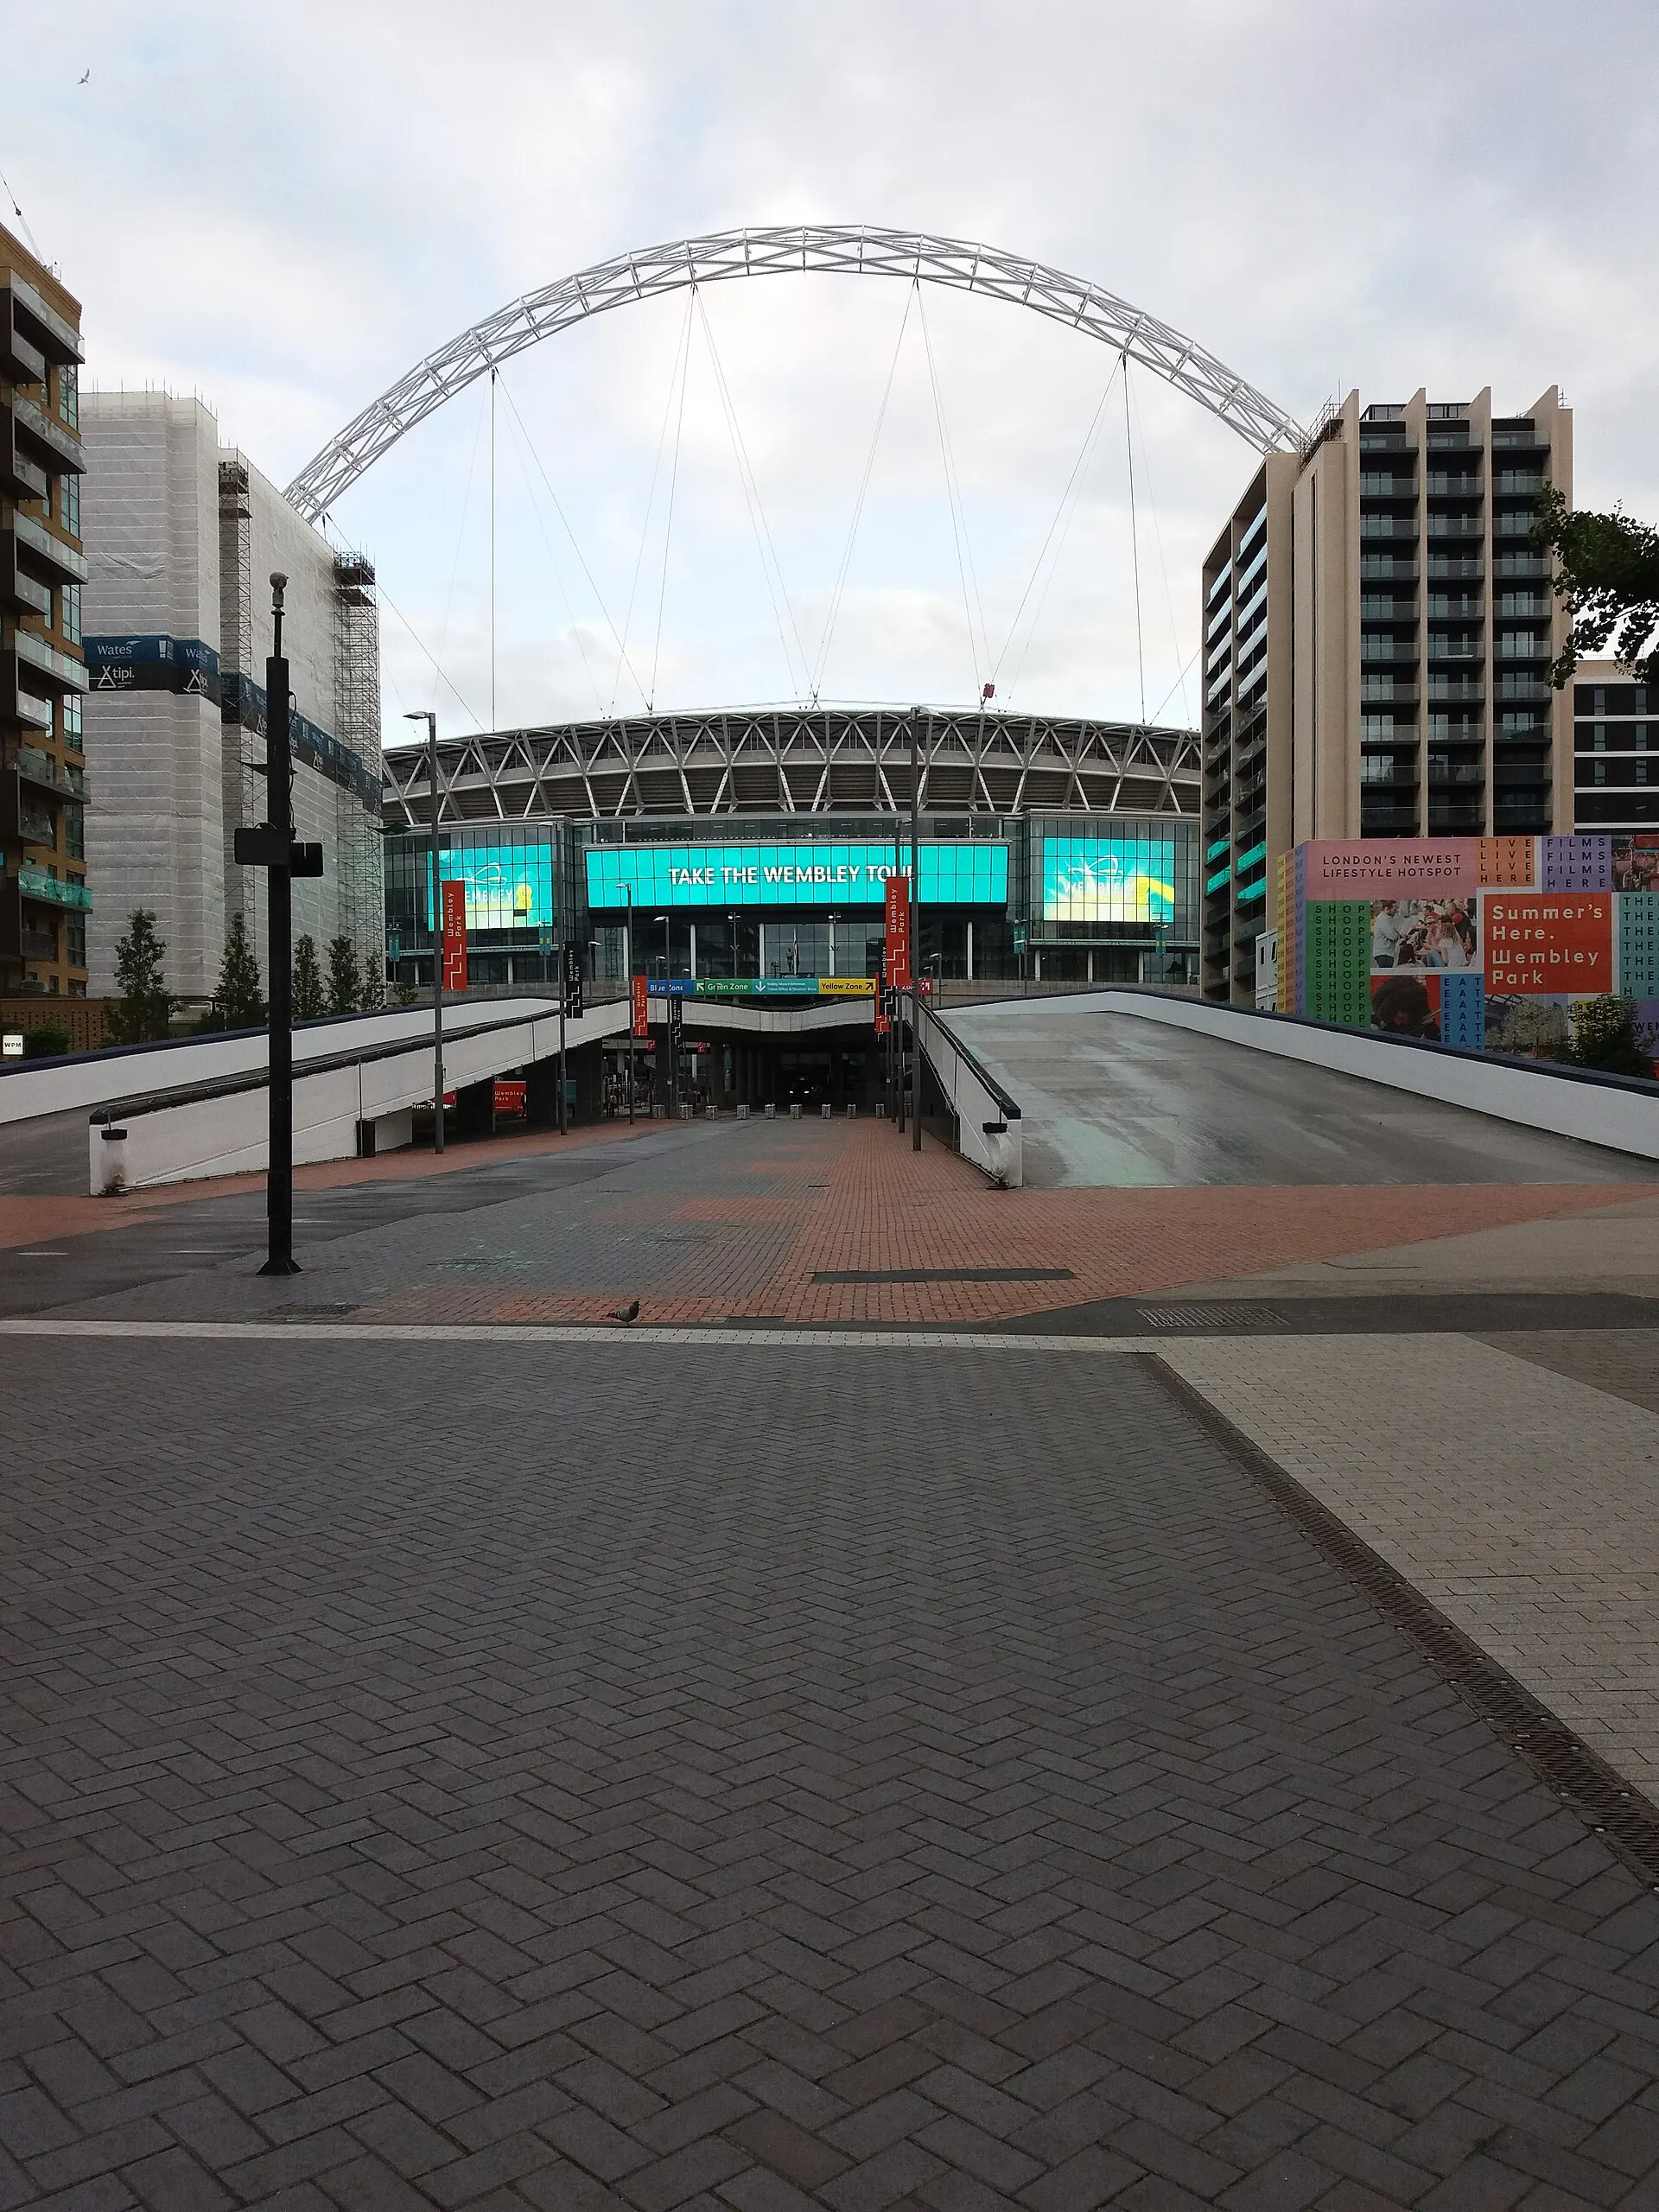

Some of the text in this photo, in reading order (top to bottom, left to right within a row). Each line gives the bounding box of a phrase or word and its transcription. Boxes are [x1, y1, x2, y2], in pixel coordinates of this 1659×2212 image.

[97, 645, 132, 656] Wates
[1480, 839, 1531, 848] LIVE
[1547, 838, 1605, 847] FILMS
[1323, 855, 1461, 864] LONDON'S NEWEST
[1480, 851, 1531, 859] LIVE
[1547, 852, 1605, 861] FILMS
[1480, 863, 1531, 871] LIVE
[1547, 865, 1605, 874] FILMS
[668, 865, 912, 885] TAKE THE WEMBLEY TOU
[1323, 868, 1461, 877] LIFESTYLE HOTSPOT
[1480, 874, 1531, 883] HERE
[1547, 879, 1605, 888] HERE
[466, 889, 513, 903] EMBLEY
[1624, 897, 1659, 906] THE
[1315, 905, 1365, 913] SHOP
[1492, 904, 1602, 920] Summer's
[1315, 916, 1365, 924] SHOP
[1624, 912, 1659, 920] THE
[1315, 927, 1365, 935] SHOP
[1492, 926, 1554, 940] Here.
[1624, 927, 1659, 936] THE
[1315, 938, 1365, 946] SHOP
[1624, 942, 1659, 950] THE
[1315, 949, 1365, 957] SHOP
[1492, 949, 1599, 966] Wembley
[1315, 960, 1365, 968] SHOP
[1624, 957, 1659, 965] THE
[1315, 971, 1365, 979] SHOP
[1492, 969, 1543, 985] Park
[1624, 971, 1659, 980] THE
[1315, 982, 1365, 990] SHOP
[1315, 993, 1365, 1001] SHOP
[1315, 1004, 1365, 1012] SHOP
[1444, 1034, 1481, 1042] EAT
